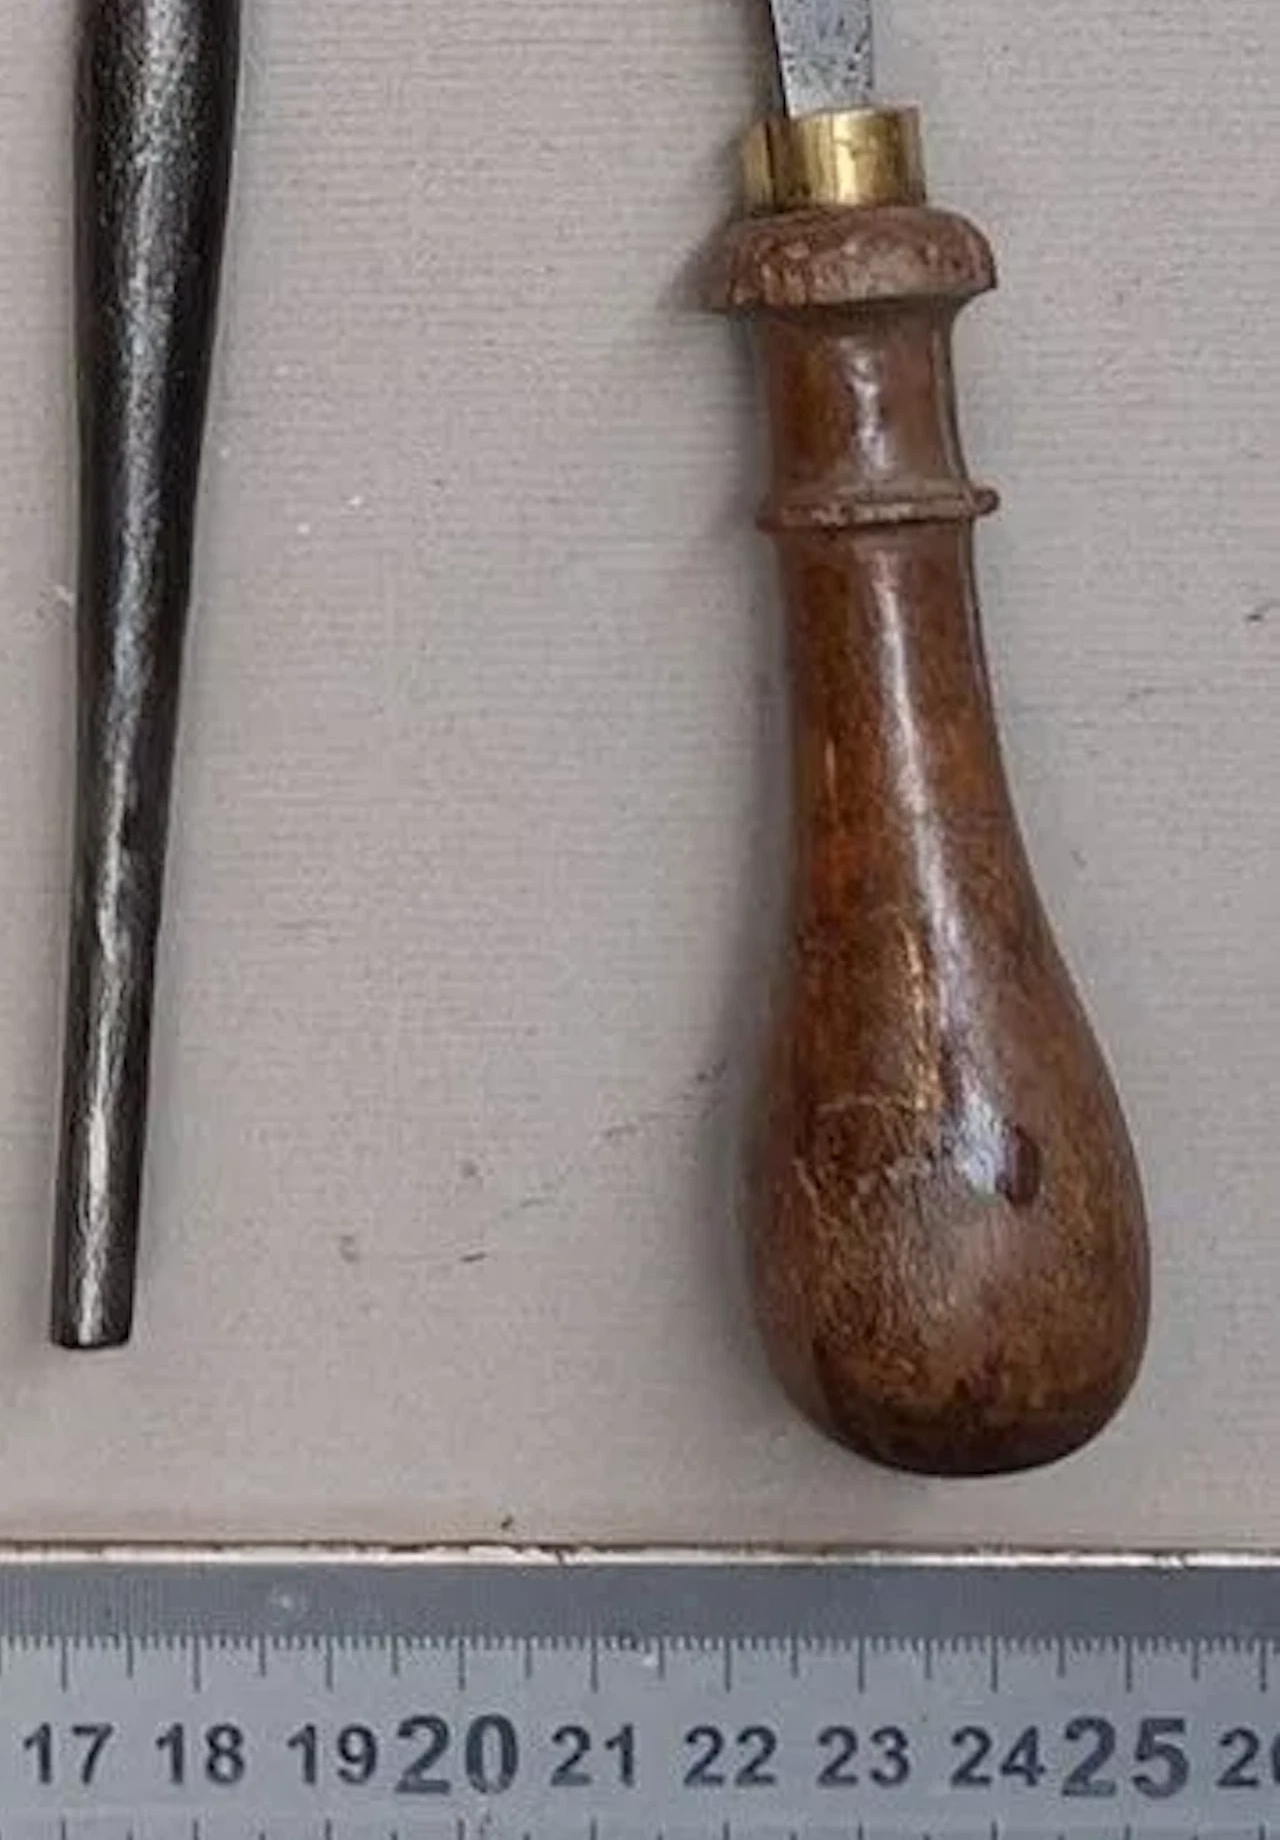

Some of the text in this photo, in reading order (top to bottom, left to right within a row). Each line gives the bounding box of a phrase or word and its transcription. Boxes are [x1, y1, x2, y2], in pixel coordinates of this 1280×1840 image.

[23, 1723, 113, 1785] 17
[155, 1723, 245, 1785] 18
[287, 1724, 378, 1785] 19
[395, 1714, 518, 1795] 20
[551, 1724, 634, 1787] 21
[684, 1725, 777, 1787] 22
[818, 1726, 910, 1787] 23
[951, 1726, 1046, 1787] 24
[1061, 1717, 1189, 1798] 25
[1217, 1727, 1280, 1788] 2
